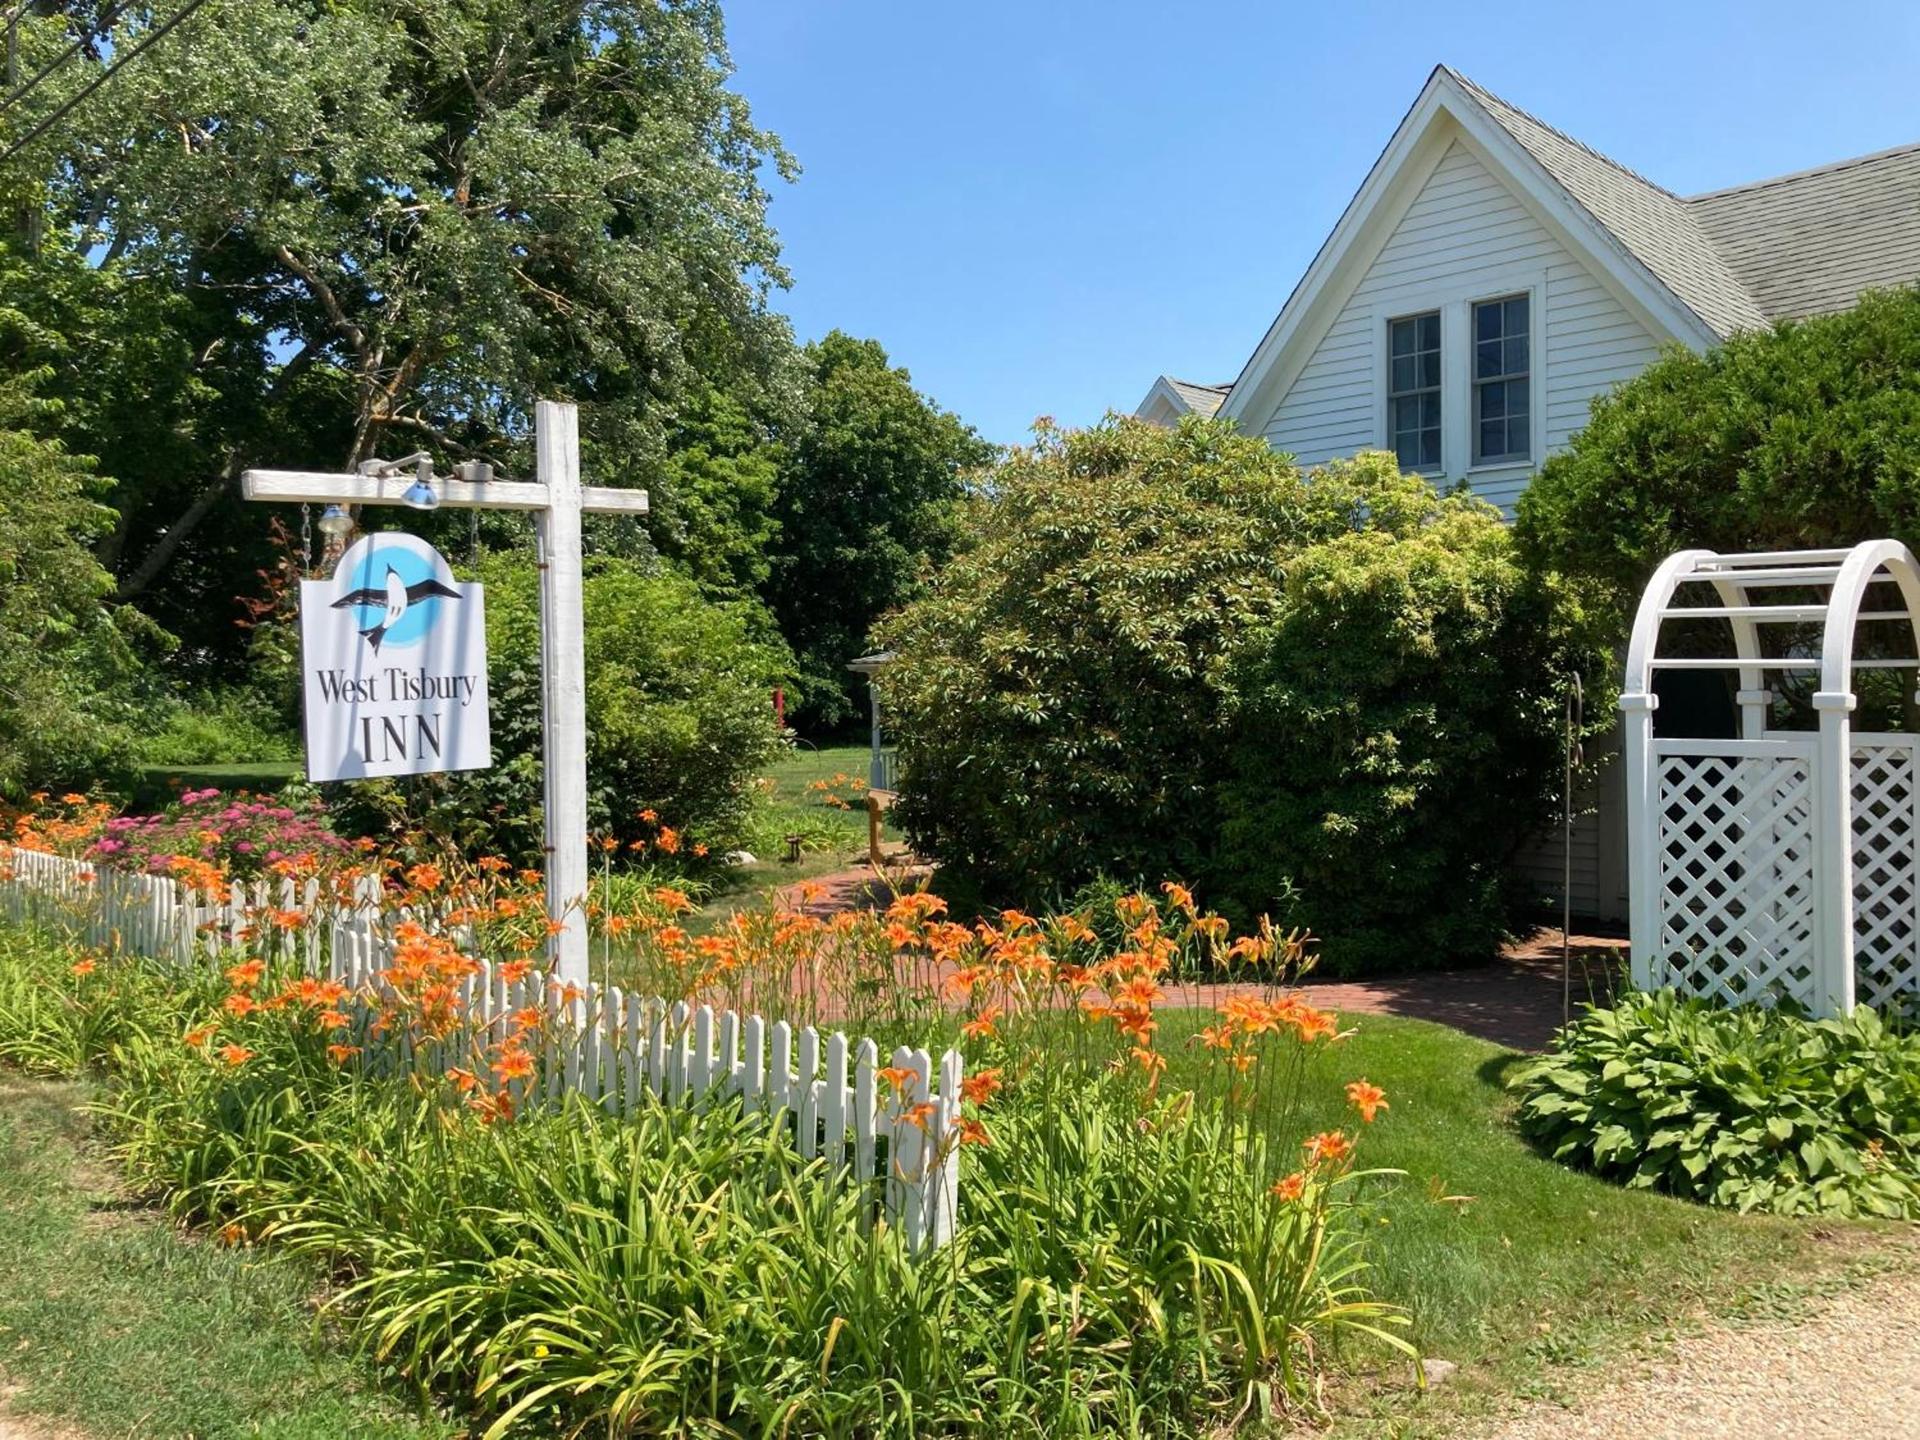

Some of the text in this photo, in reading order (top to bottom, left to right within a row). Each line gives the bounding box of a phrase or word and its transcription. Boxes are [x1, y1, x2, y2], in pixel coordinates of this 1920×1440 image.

[317, 667, 477, 707] West Tisbury
[360, 713, 442, 763] INN
